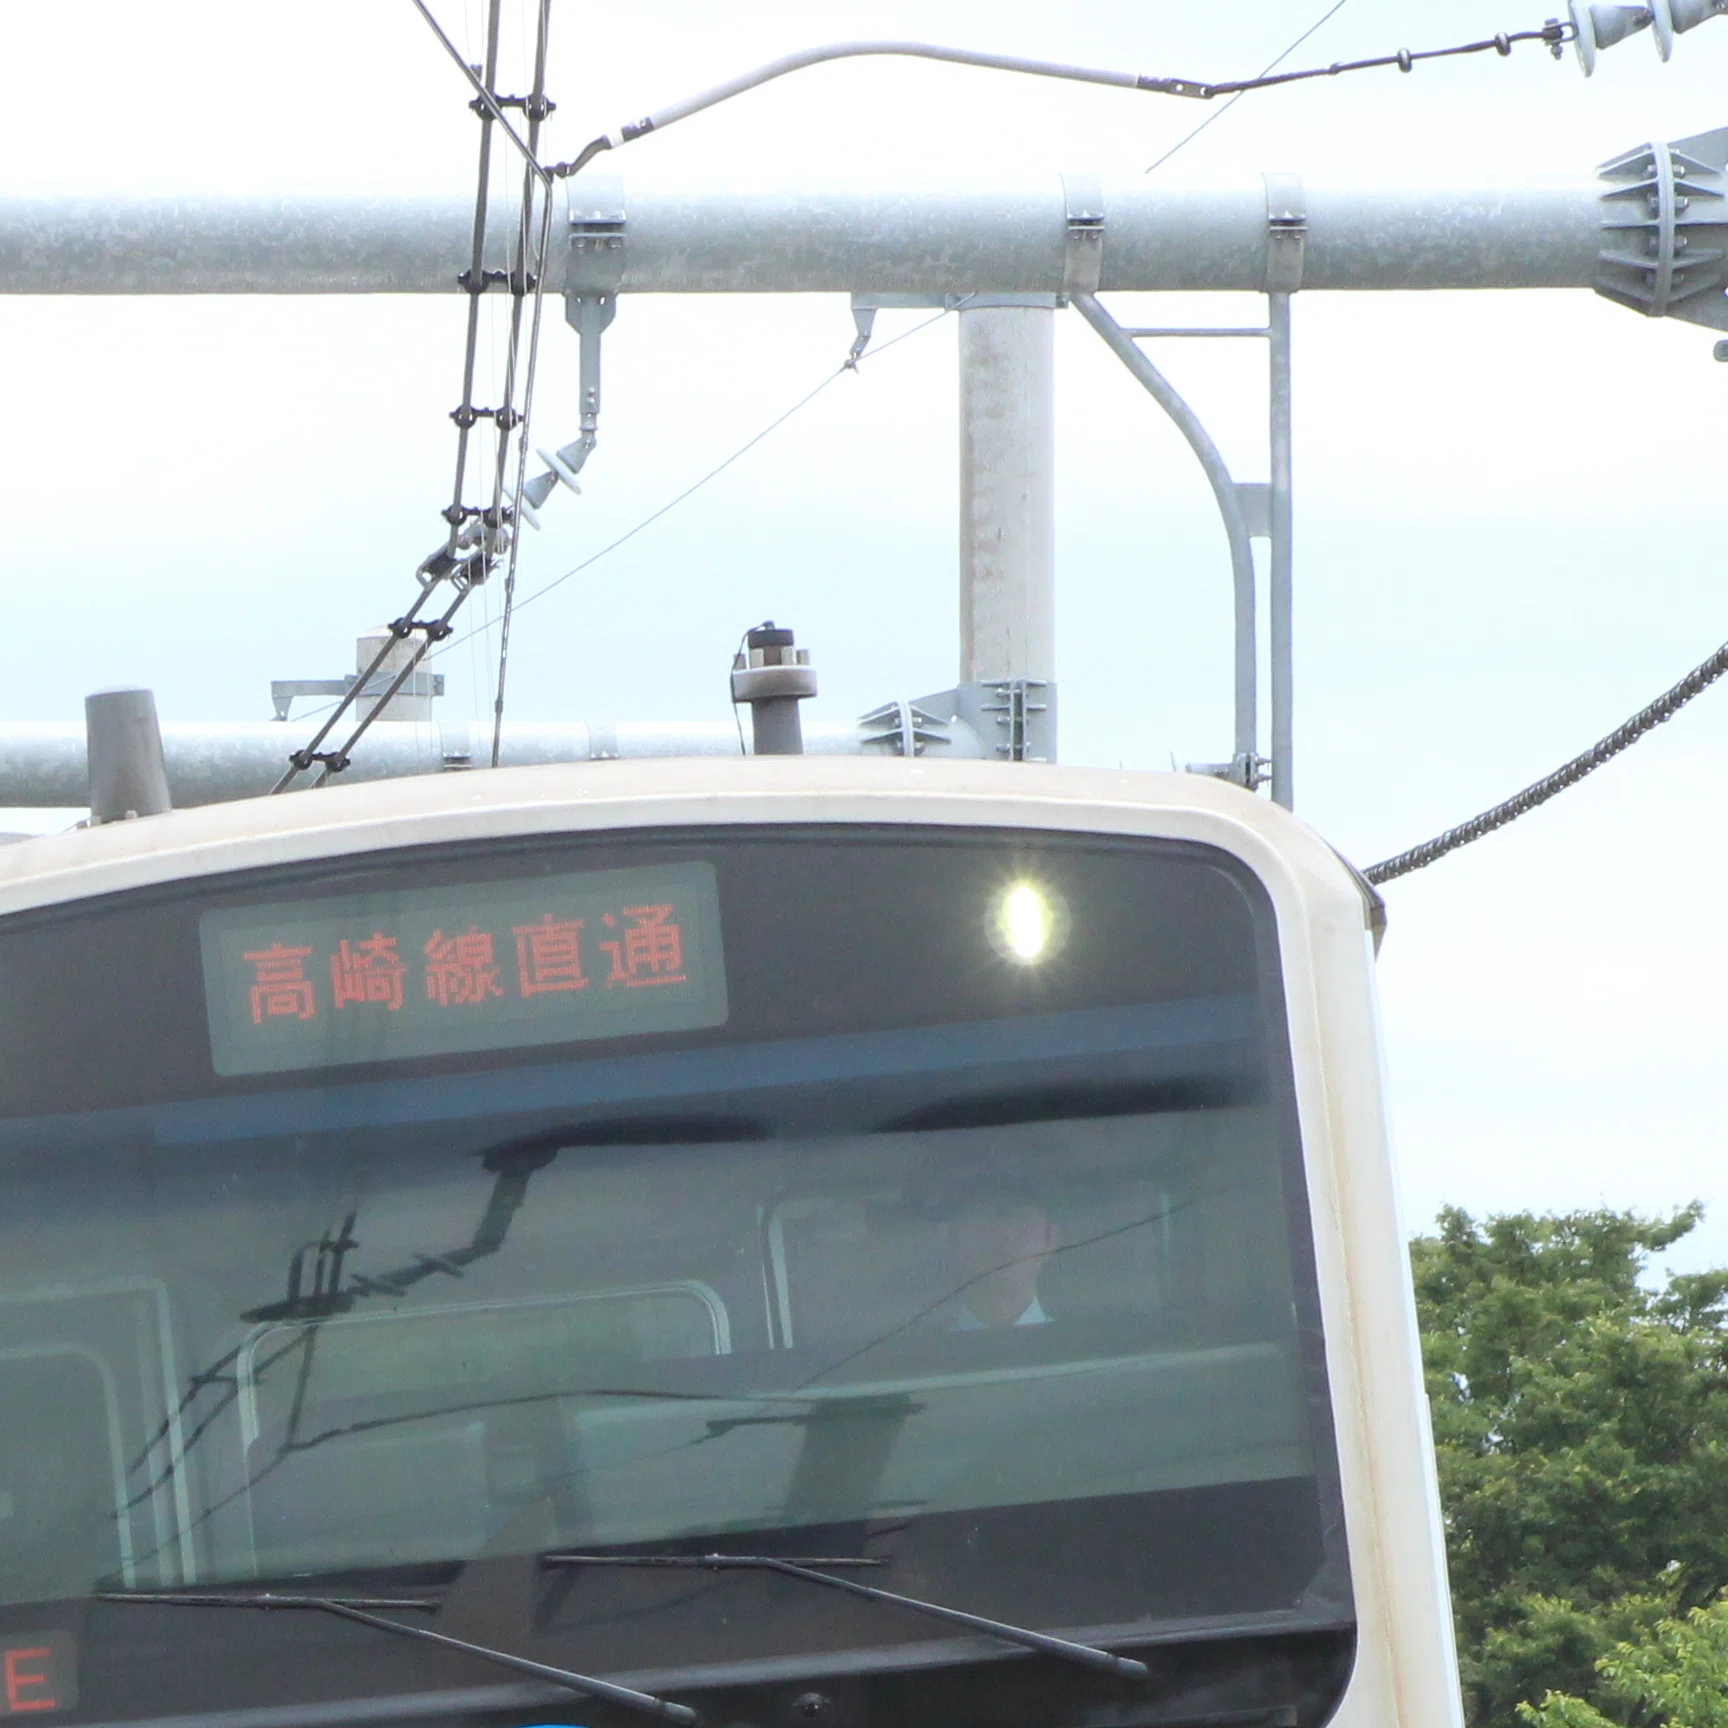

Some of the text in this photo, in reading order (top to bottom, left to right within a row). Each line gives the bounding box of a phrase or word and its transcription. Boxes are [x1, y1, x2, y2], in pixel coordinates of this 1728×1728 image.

[243, 903, 687, 1025] 高崎線直通
